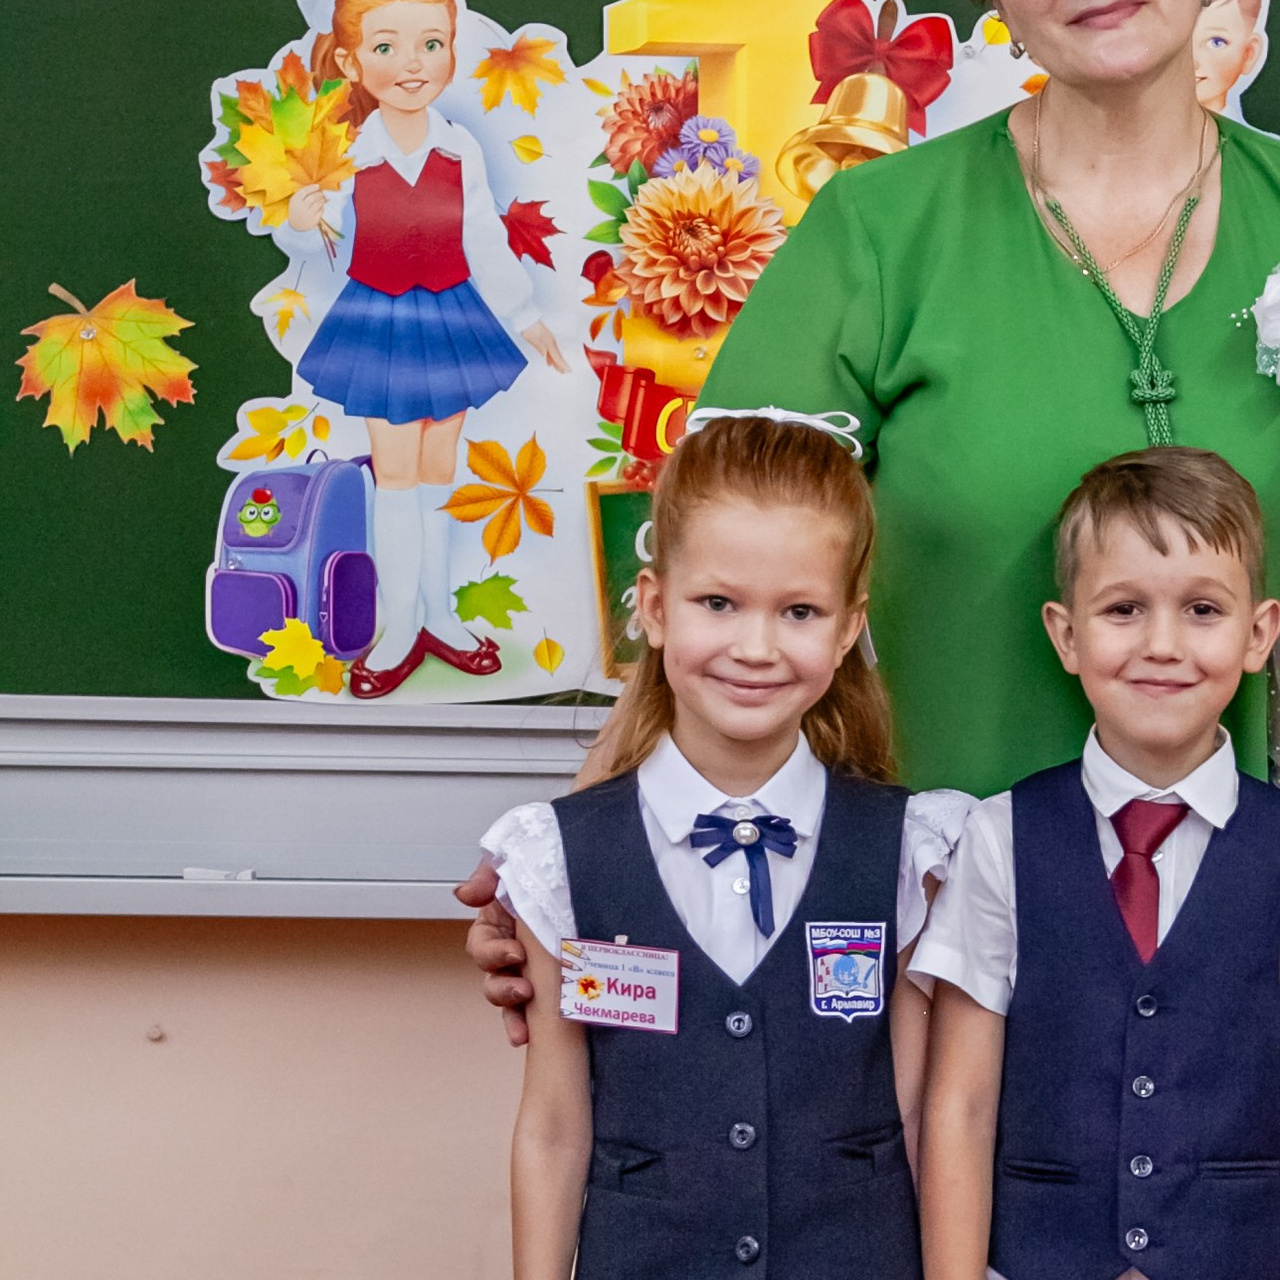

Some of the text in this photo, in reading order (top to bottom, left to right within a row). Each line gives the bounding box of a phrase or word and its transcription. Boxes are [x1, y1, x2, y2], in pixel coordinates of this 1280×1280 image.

[606, 977, 656, 1001] Кира
[574, 1002, 655, 1024] Чекмарева
[831, 998, 875, 1011] Армавир
